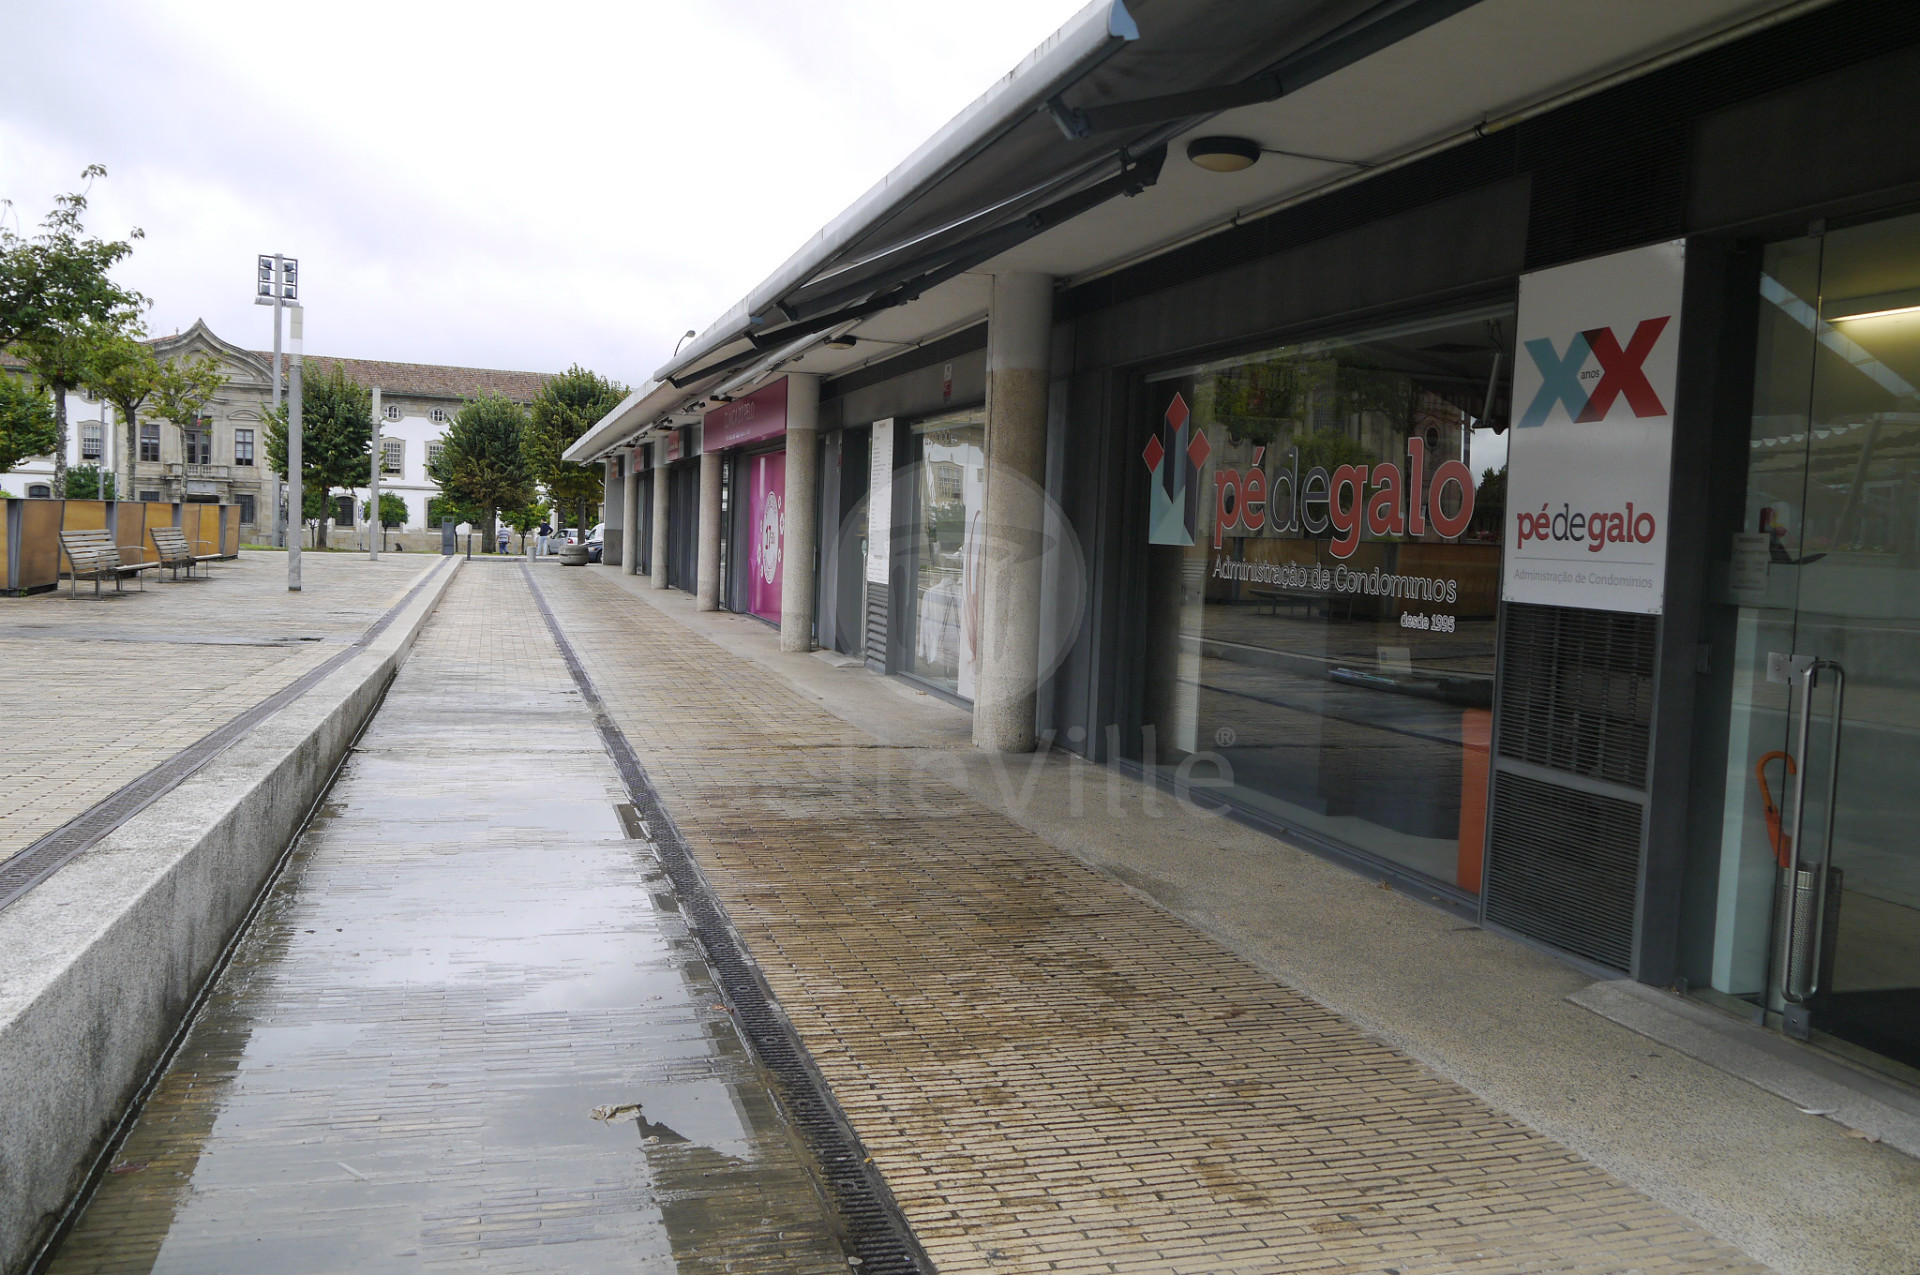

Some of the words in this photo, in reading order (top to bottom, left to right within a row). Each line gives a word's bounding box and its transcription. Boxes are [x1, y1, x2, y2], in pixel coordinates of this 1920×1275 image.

[1580, 368, 1600, 380] anos
[1212, 554, 1308, 588] Administração
[1312, 563, 1331, 590] de
[1514, 569, 1573, 585] Administração
[1575, 572, 1586, 584] de
[1400, 611, 1429, 629] desde
[1430, 613, 1456, 633] 1995
